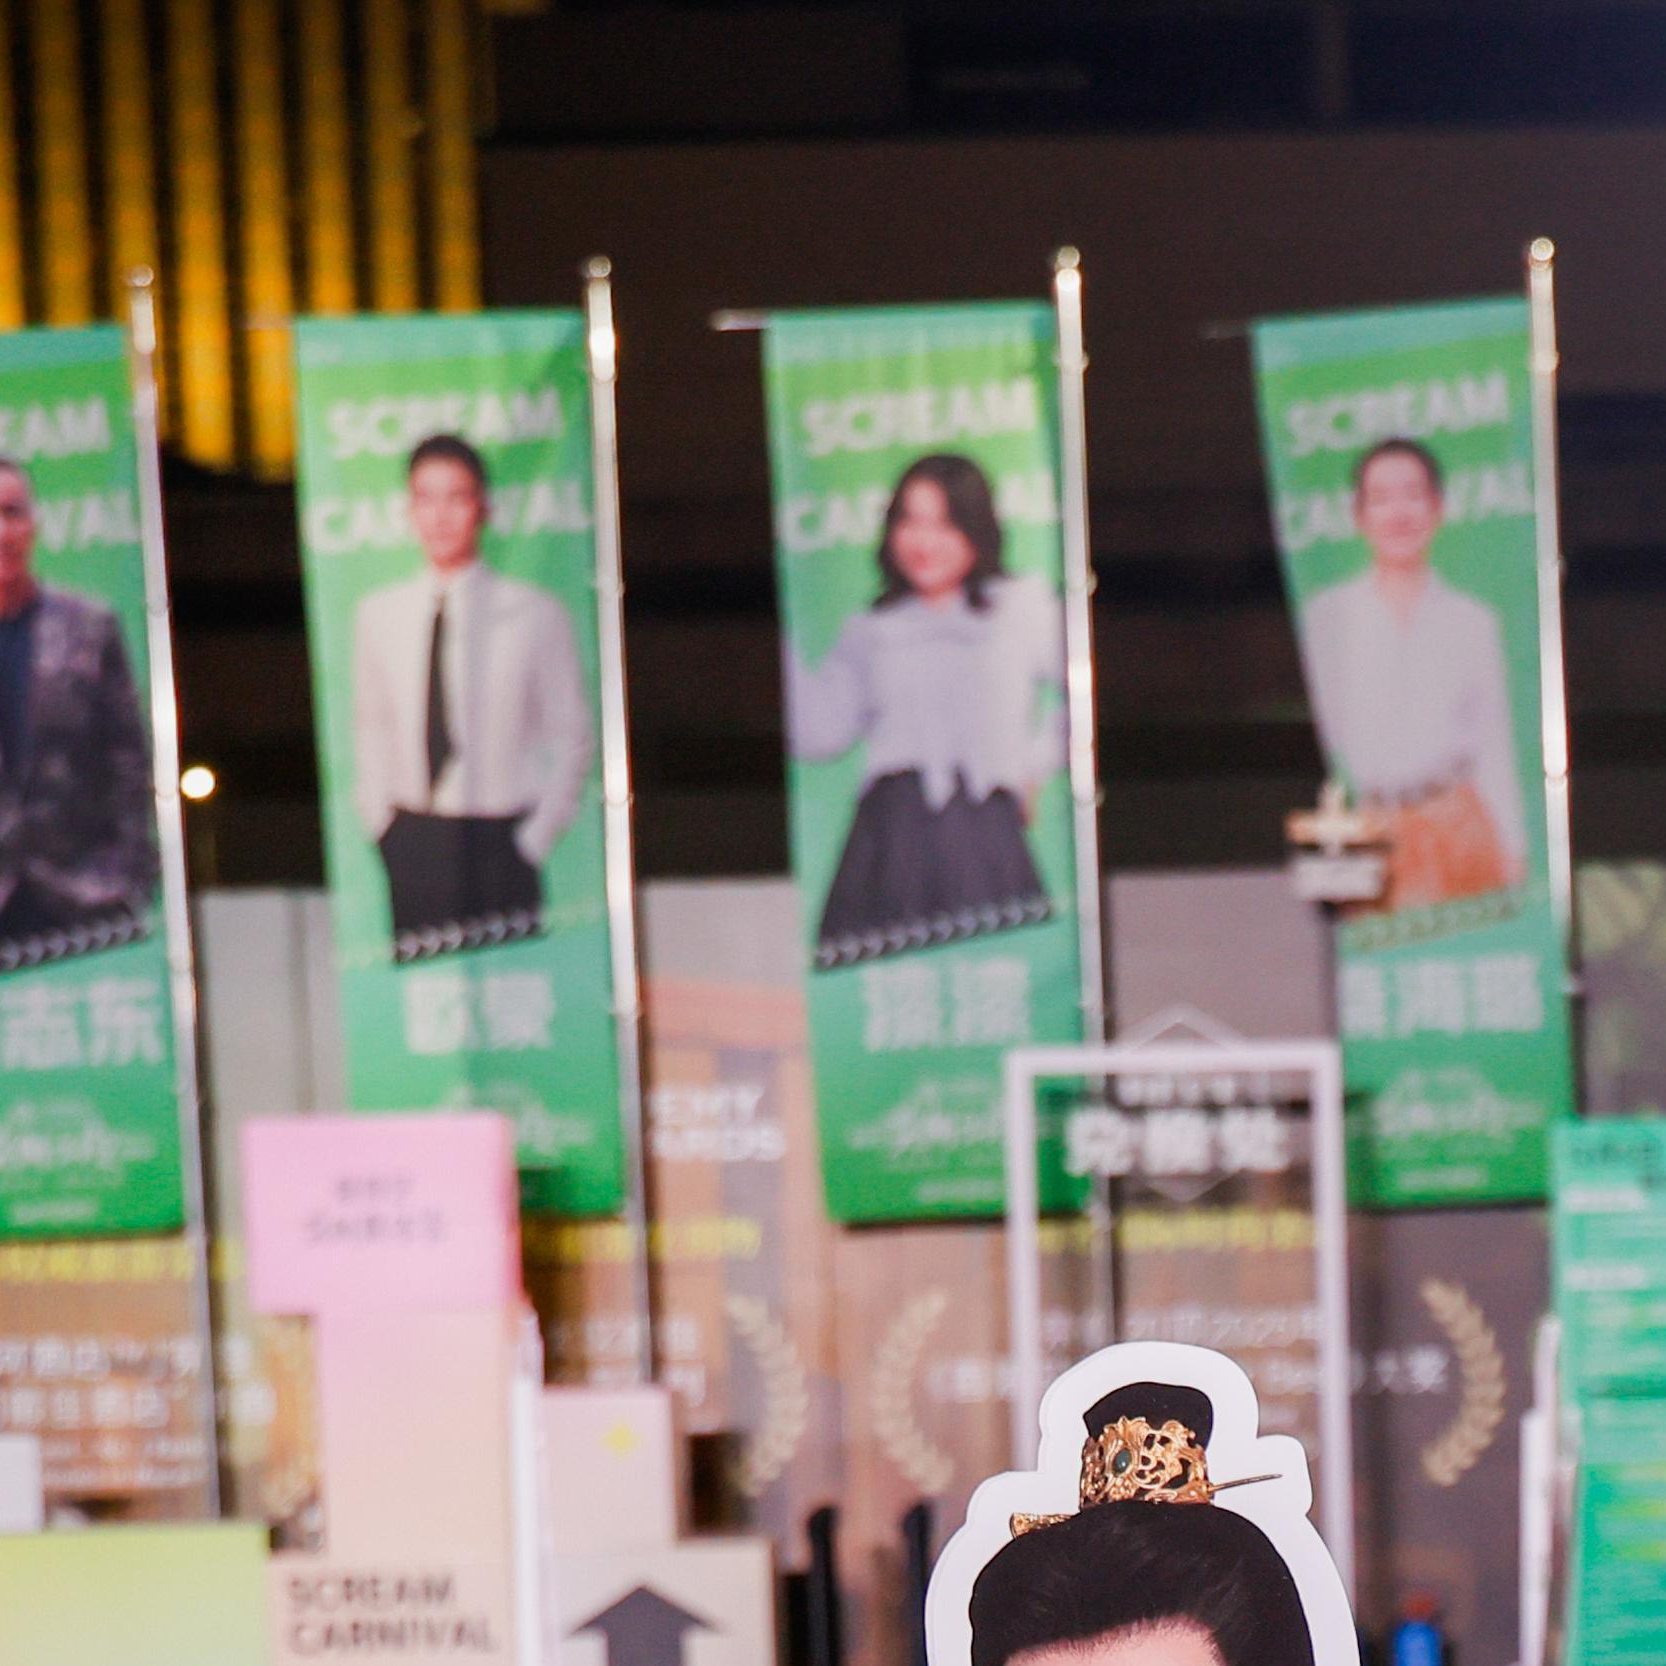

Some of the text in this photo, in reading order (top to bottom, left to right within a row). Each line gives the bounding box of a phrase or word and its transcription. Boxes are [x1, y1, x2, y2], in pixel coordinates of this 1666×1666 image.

[803, 379, 1036, 456] SCREAM
[1286, 373, 1509, 456] SCREAM
[310, 481, 593, 553] CAVAL
[780, 474, 1057, 553] CAAL
[1279, 465, 1534, 549] CAVAL
[289, 1572, 458, 1606] SCREAM
[290, 1614, 499, 1656] CARNIVAL
